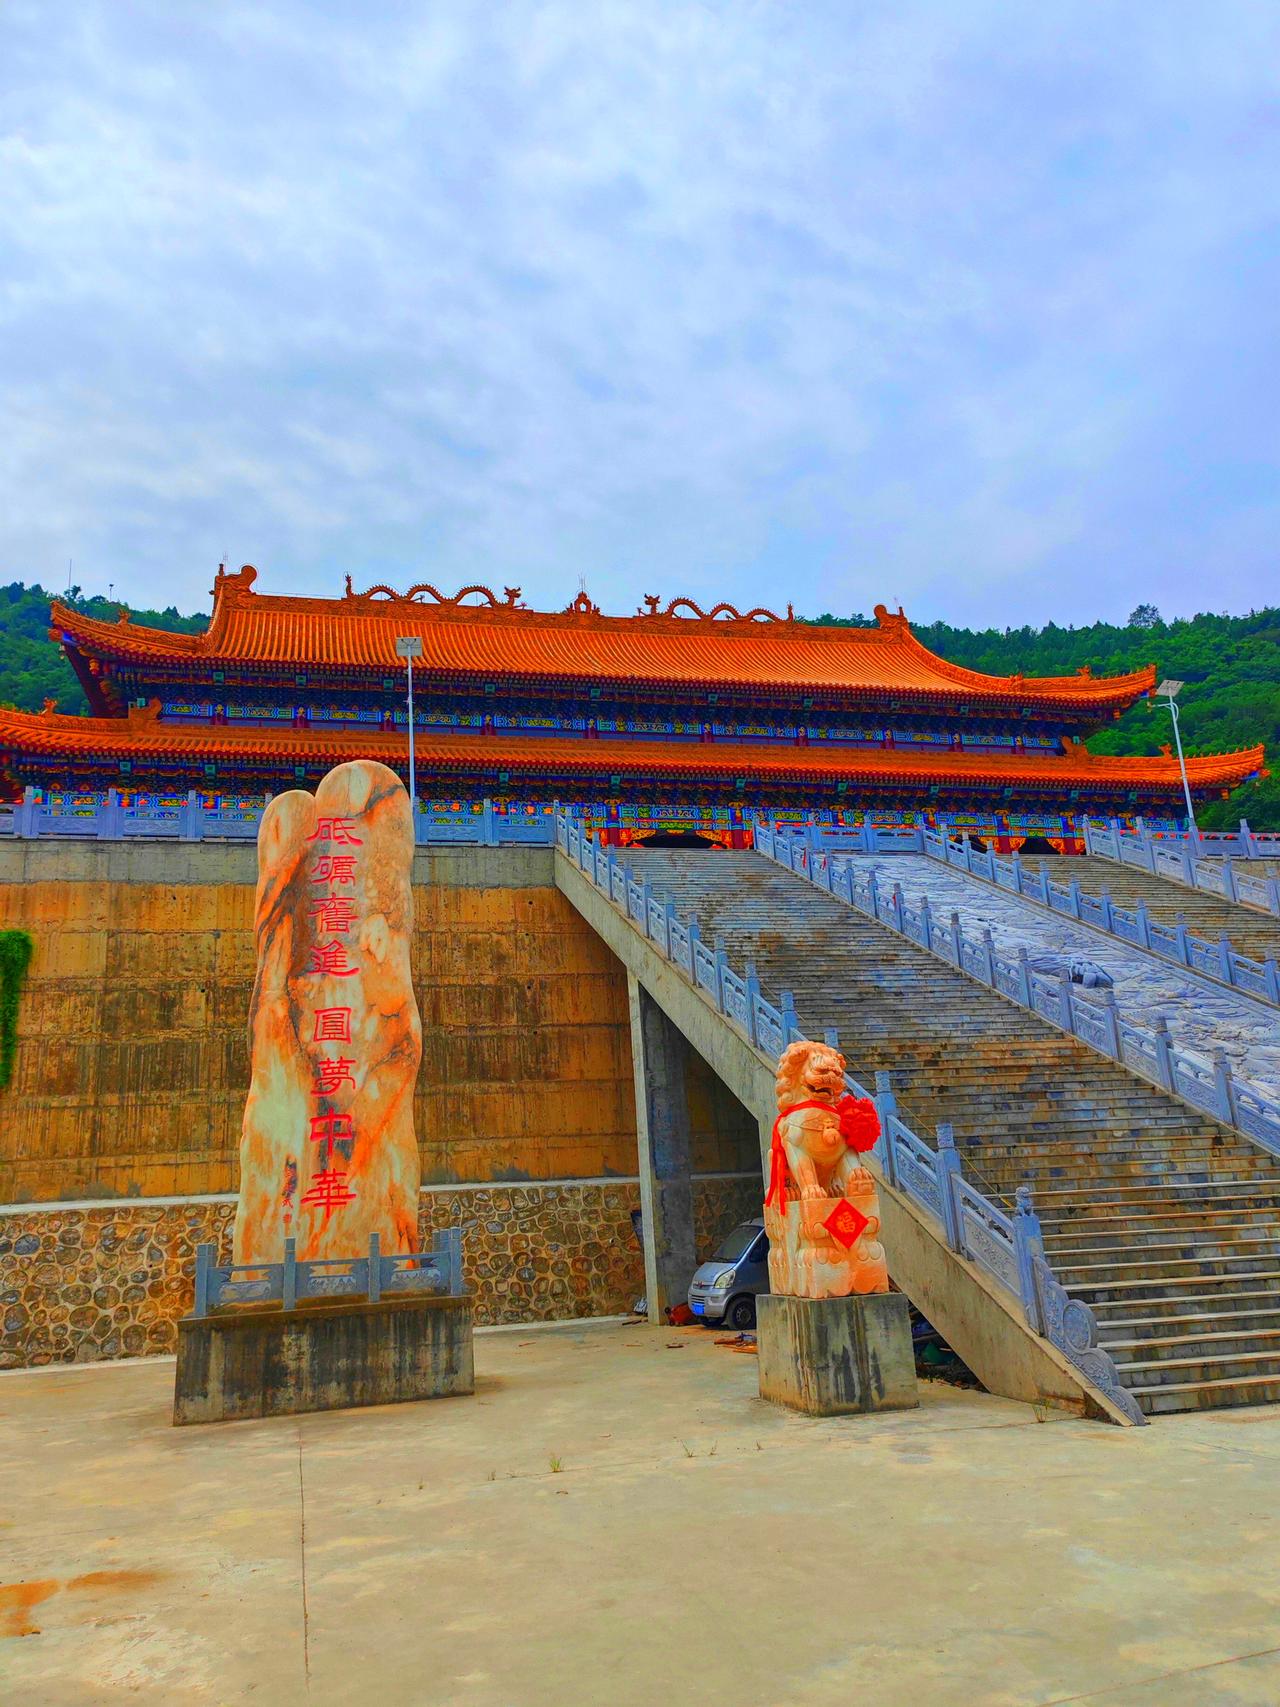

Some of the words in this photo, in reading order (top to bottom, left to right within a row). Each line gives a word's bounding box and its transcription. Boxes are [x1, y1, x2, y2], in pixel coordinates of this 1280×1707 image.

[301, 1007, 357, 1219] 圓夢中華
[836, 1211, 856, 1232] 福
